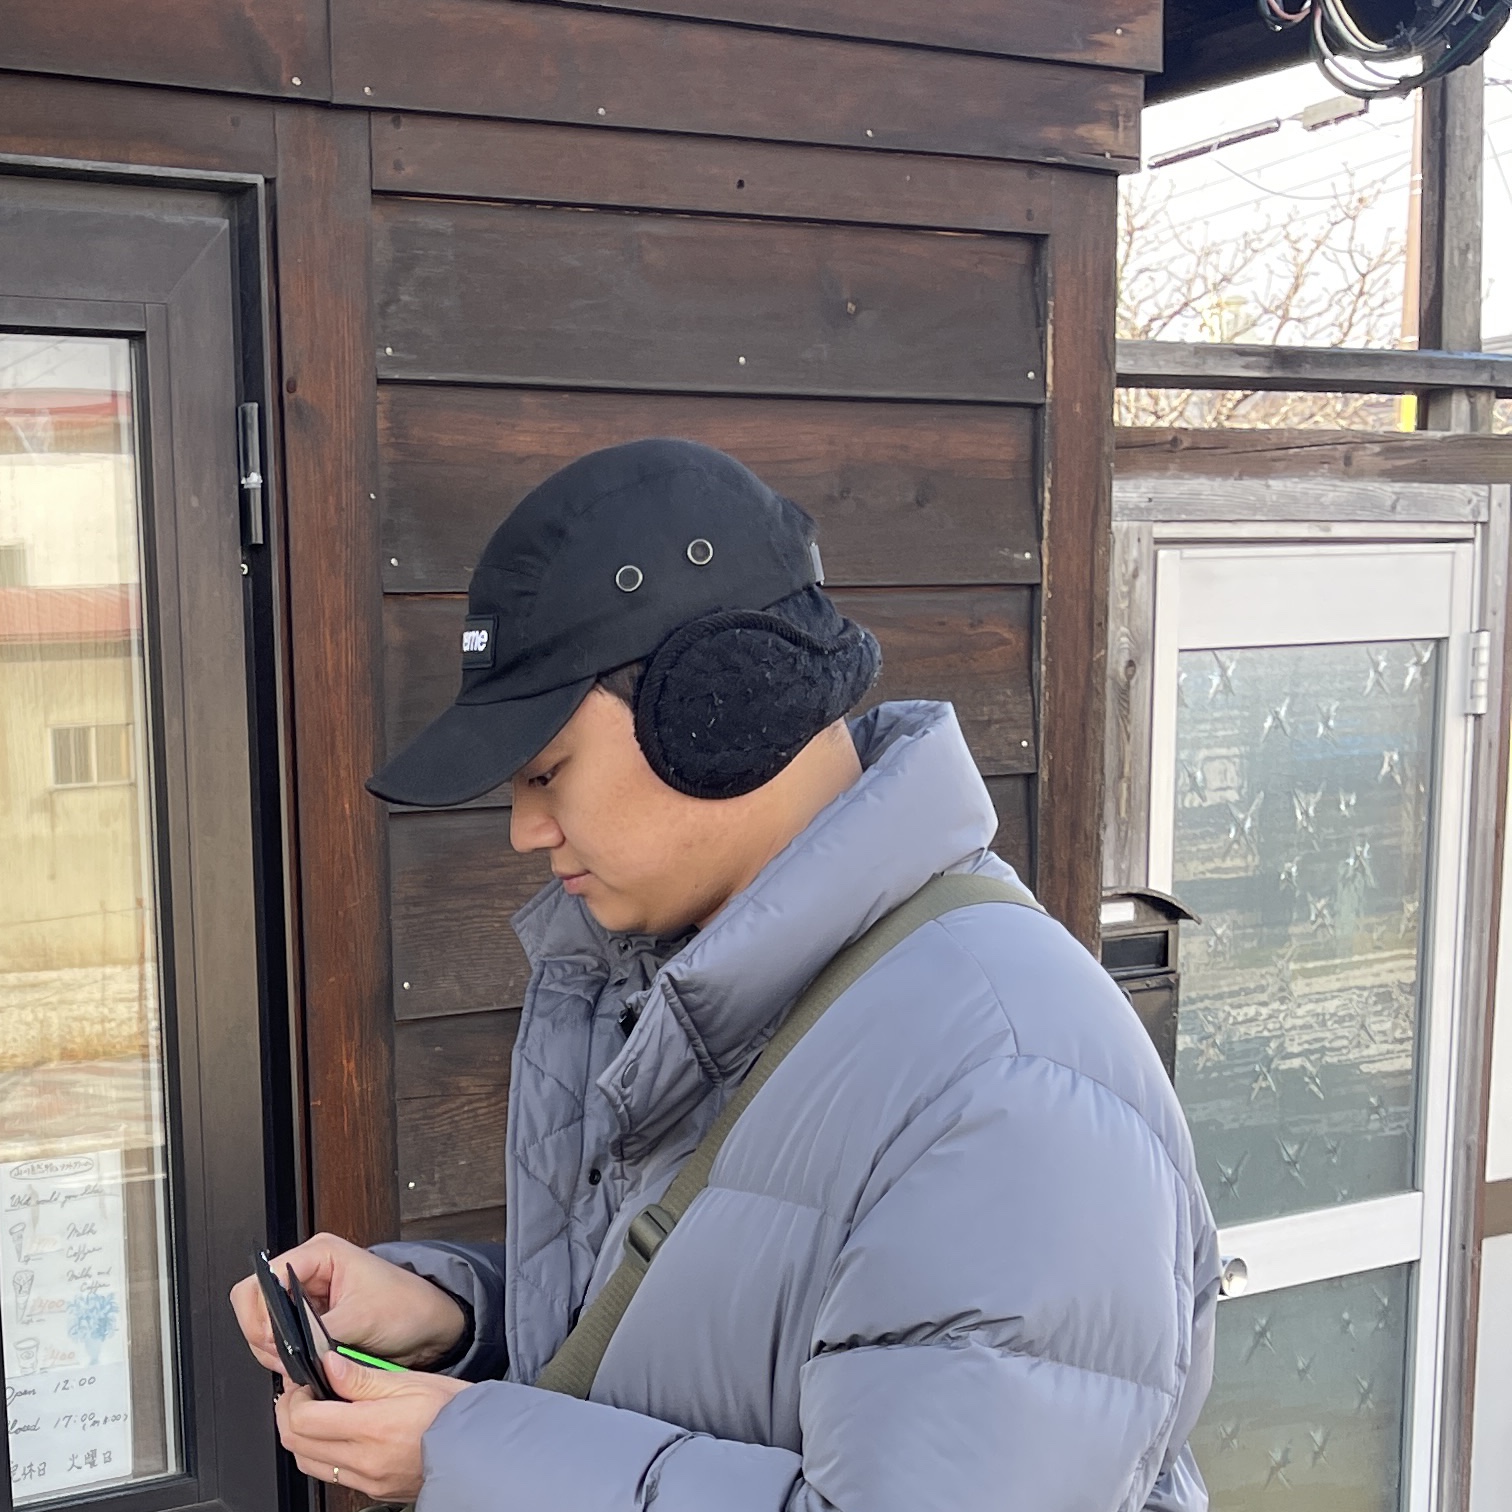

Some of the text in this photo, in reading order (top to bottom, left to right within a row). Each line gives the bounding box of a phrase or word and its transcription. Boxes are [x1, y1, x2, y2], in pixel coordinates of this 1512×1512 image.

[53, 1376, 97, 1393] 12:00
[8, 1416, 41, 1436] losed
[53, 1411, 96, 1429] 17:00
[66, 1448, 113, 1472] 火曜日
